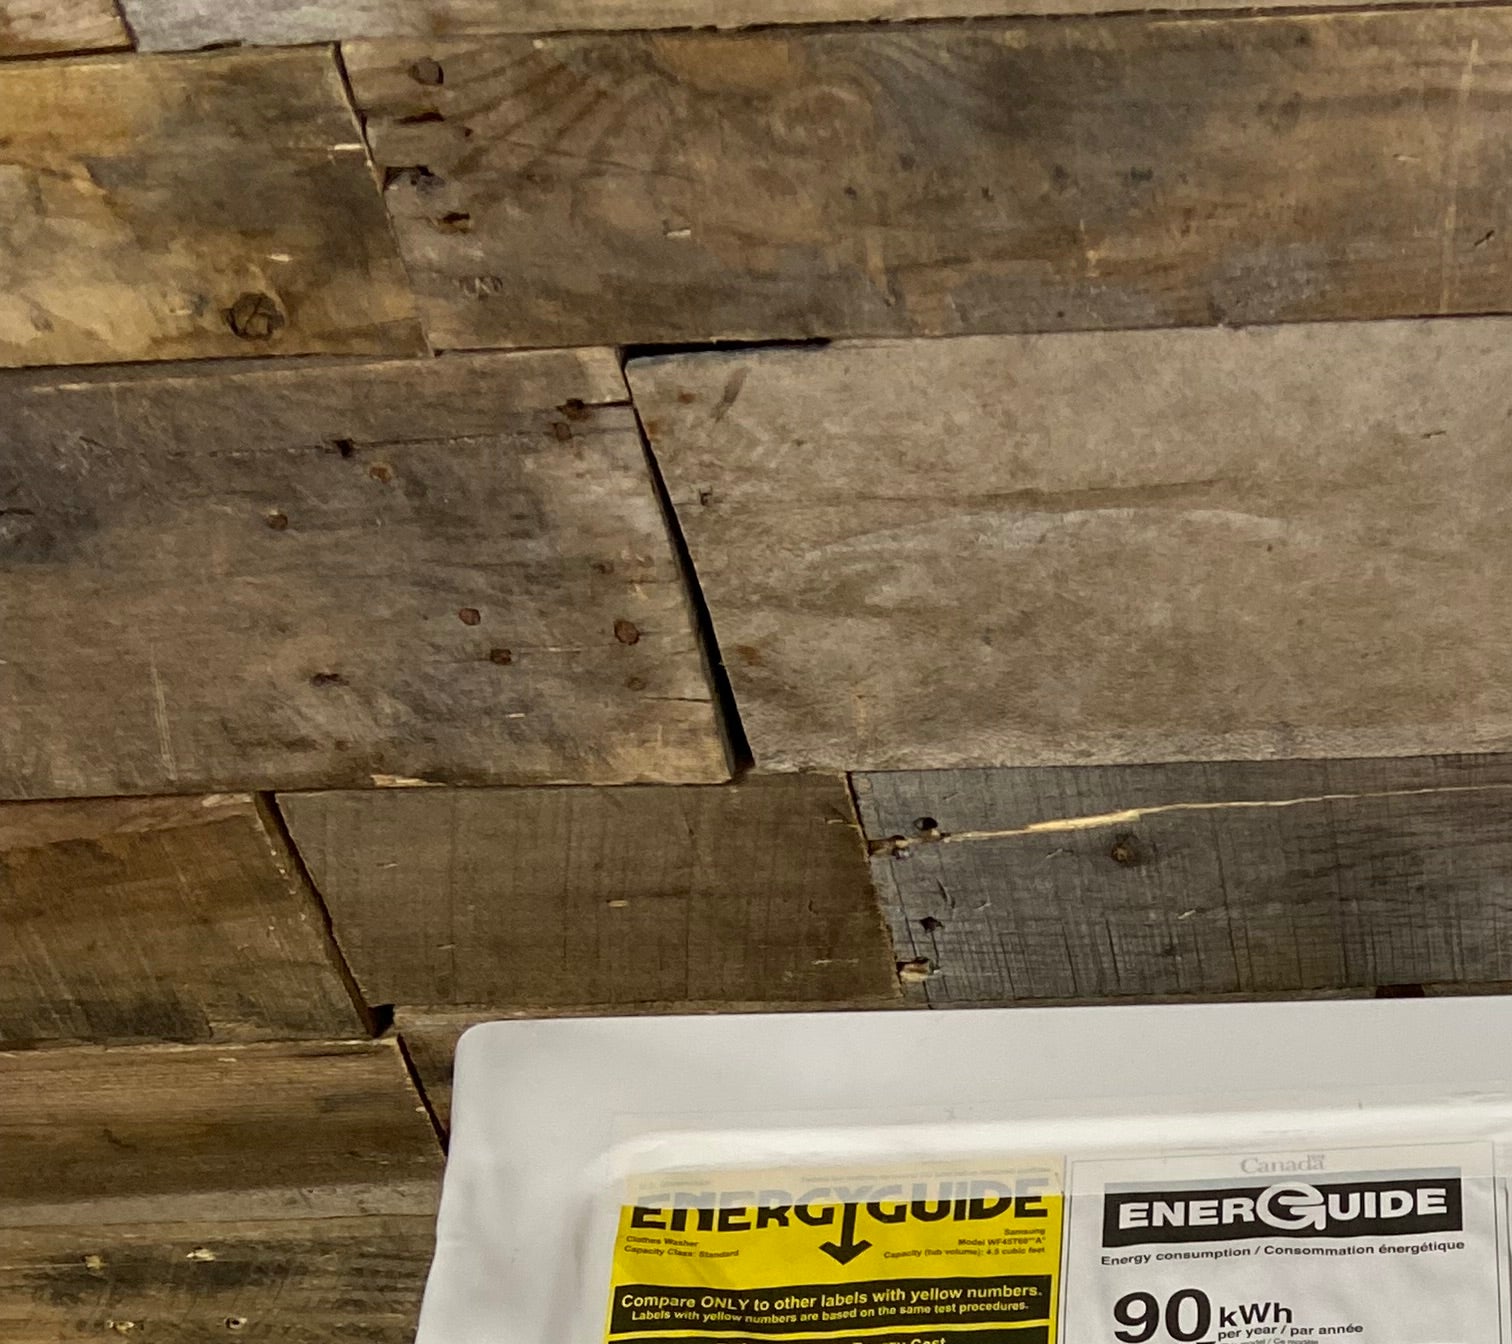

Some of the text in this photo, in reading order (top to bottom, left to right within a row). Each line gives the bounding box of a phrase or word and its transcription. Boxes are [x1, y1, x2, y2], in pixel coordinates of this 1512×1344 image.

[1119, 1181, 1447, 1231] ENERGUIDE
[664, 1237, 699, 1247] Washer
[958, 1238, 985, 1246] Model
[1004, 1228, 1046, 1236] Samsung
[624, 1246, 664, 1256] Capacity
[699, 1250, 739, 1258] Standard
[1101, 1240, 1465, 1265] Energy consumption Consommation énergétique
[622, 1285, 1043, 1311] Compare ONLY to other labels with yellow numbers.
[632, 1302, 1029, 1324] Labels with yellow numbers are based on the same test procedures.
[1113, 1289, 1292, 1344] 90 kWh
[1218, 1323, 1364, 1342] per year par année
